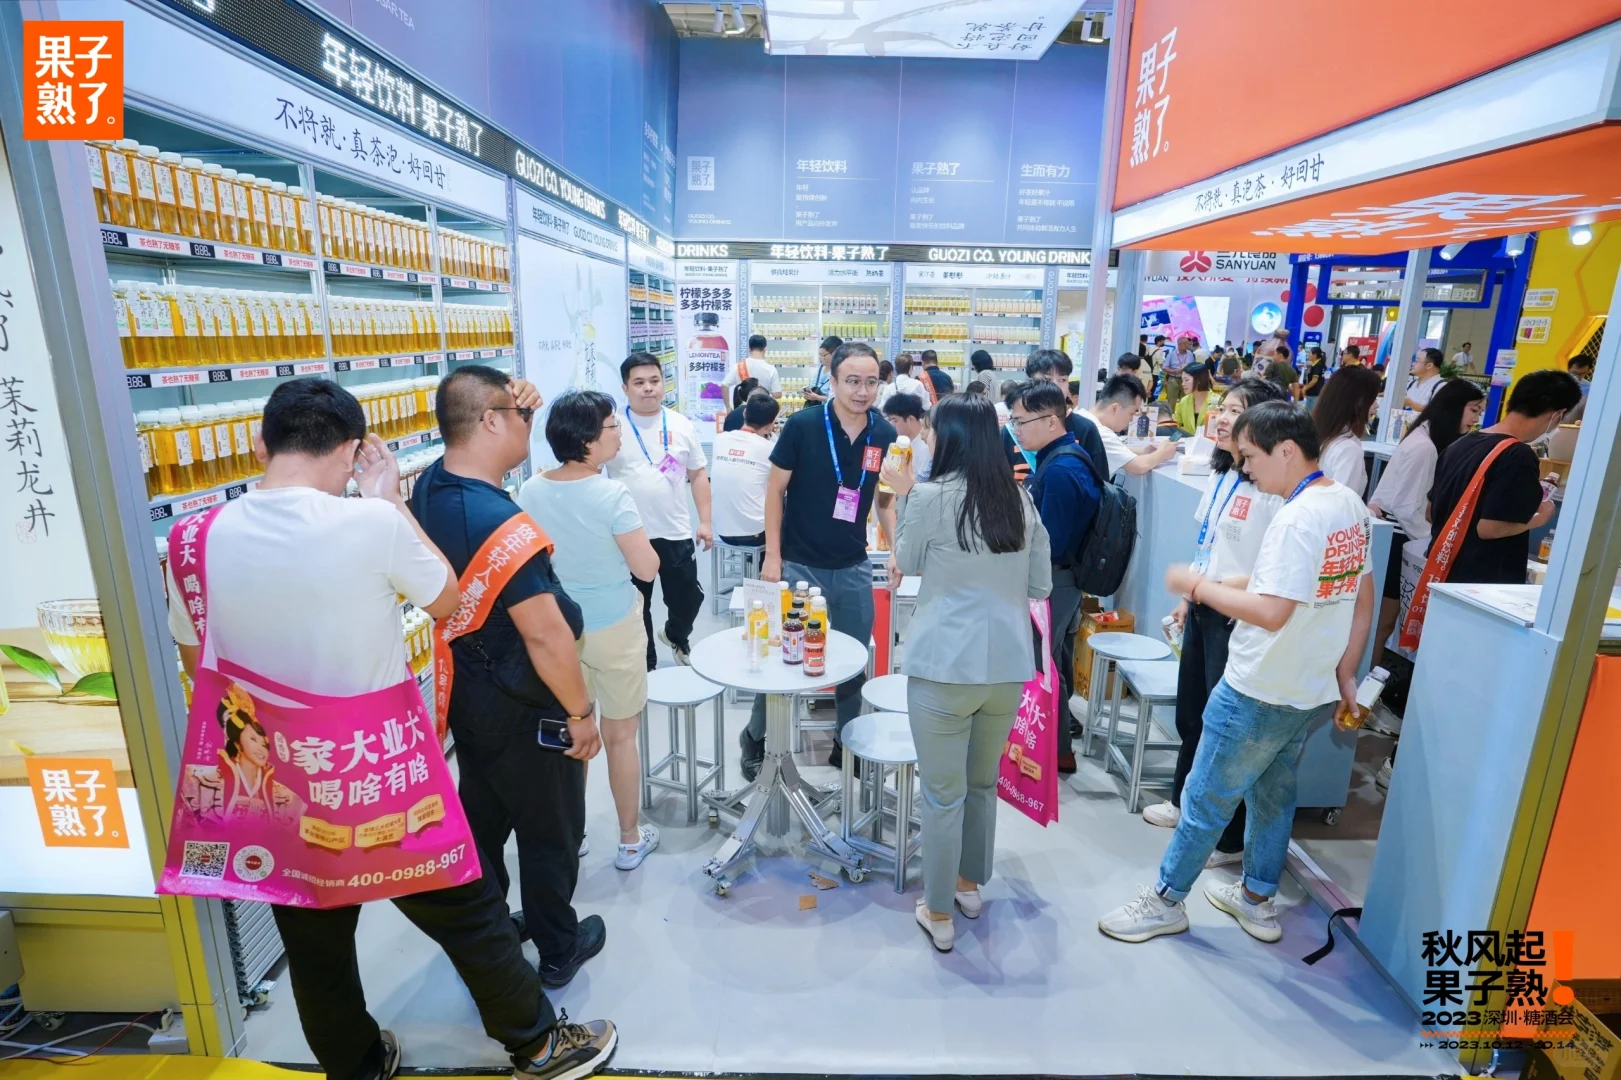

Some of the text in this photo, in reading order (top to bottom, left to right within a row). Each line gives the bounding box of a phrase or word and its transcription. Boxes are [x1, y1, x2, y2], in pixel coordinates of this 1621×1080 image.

[398, 8, 415, 31] TEA
[1136, 27, 1177, 108] 果子
[1130, 95, 1170, 168] 熟了。
[691, 160, 711, 172] 果子
[796, 159, 847, 173] 年轻饮料
[912, 162, 960, 175] 果子熟了
[1020, 164, 1070, 178] 生而有力
[515, 150, 544, 188] GUOZI
[559, 177, 584, 209] YOUNG
[139, 237, 181, 251] 茶也熟了无糖茶
[223, 249, 255, 261] 茶也熟了无糖茶
[677, 244, 729, 258] DRINKS
[770, 244, 889, 261] 年轻饮料·果子熟了
[928, 247, 1092, 264] GUOZI CO. YOUNG DRINK
[1215, 259, 1277, 270] SANYUAN
[740, 263, 748, 289] GUOZI
[680, 287, 733, 299] 柠檬多多多
[680, 299, 733, 311] 多多柠檬茶
[740, 305, 748, 334] YOUNG
[688, 351, 721, 359] LEMONTEA
[688, 361, 726, 372] 多多柠檬茶
[161, 374, 200, 384] 茶也熟了无糖茶
[239, 369, 270, 378] 茶也熟了无糖茶
[0, 376, 55, 537] 茉莉龙井
[865, 449, 880, 460] 果子
[181, 495, 218, 510] 茶也熟了无糖茶
[1326, 523, 1361, 545] YOUN
[1324, 534, 1367, 560] DRINS
[290, 710, 425, 775] 家大业大
[42, 769, 106, 803] 果子
[308, 752, 429, 810] 喝啥有啥
[48, 804, 119, 837] 熟了。
[281, 844, 466, 888] 全国诚招经销商 400-0988-967
